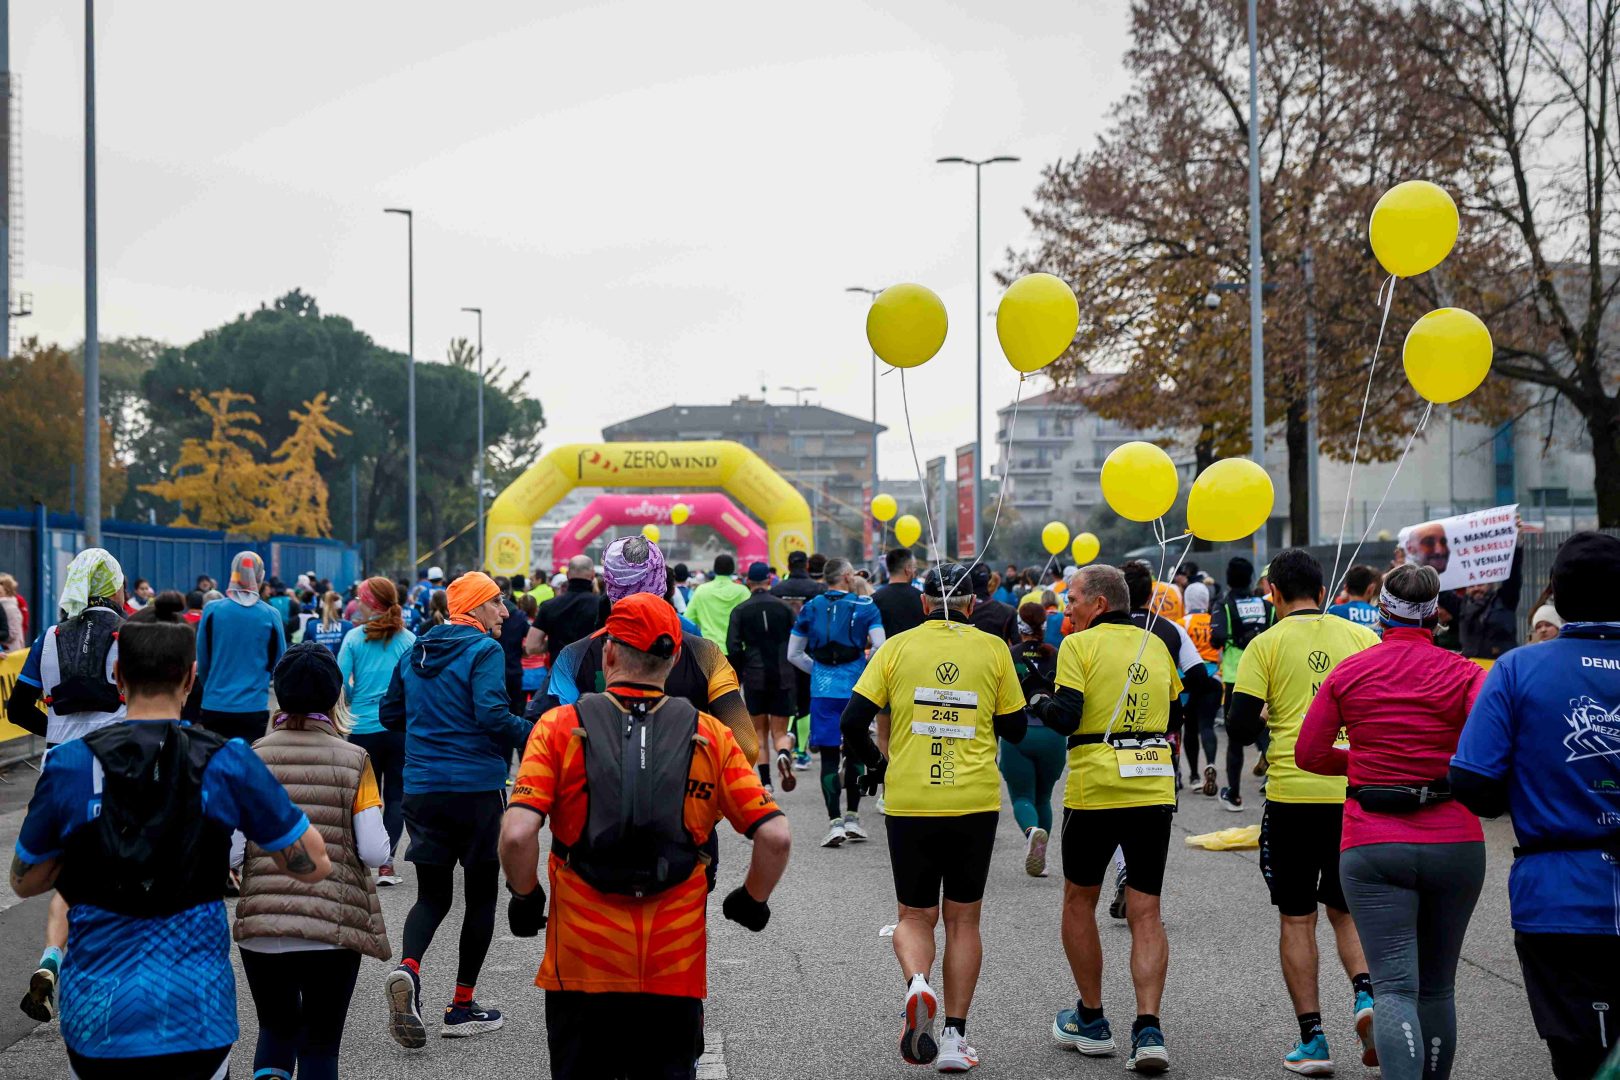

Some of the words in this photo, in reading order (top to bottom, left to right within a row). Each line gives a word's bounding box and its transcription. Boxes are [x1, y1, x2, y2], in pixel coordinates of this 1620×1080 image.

[1465, 527, 1514, 542] MANCARE
[1457, 548, 1470, 557] LA
[1461, 561, 1470, 569] TI
[932, 709, 959, 722] 2:45
[943, 750, 955, 786] 100%
